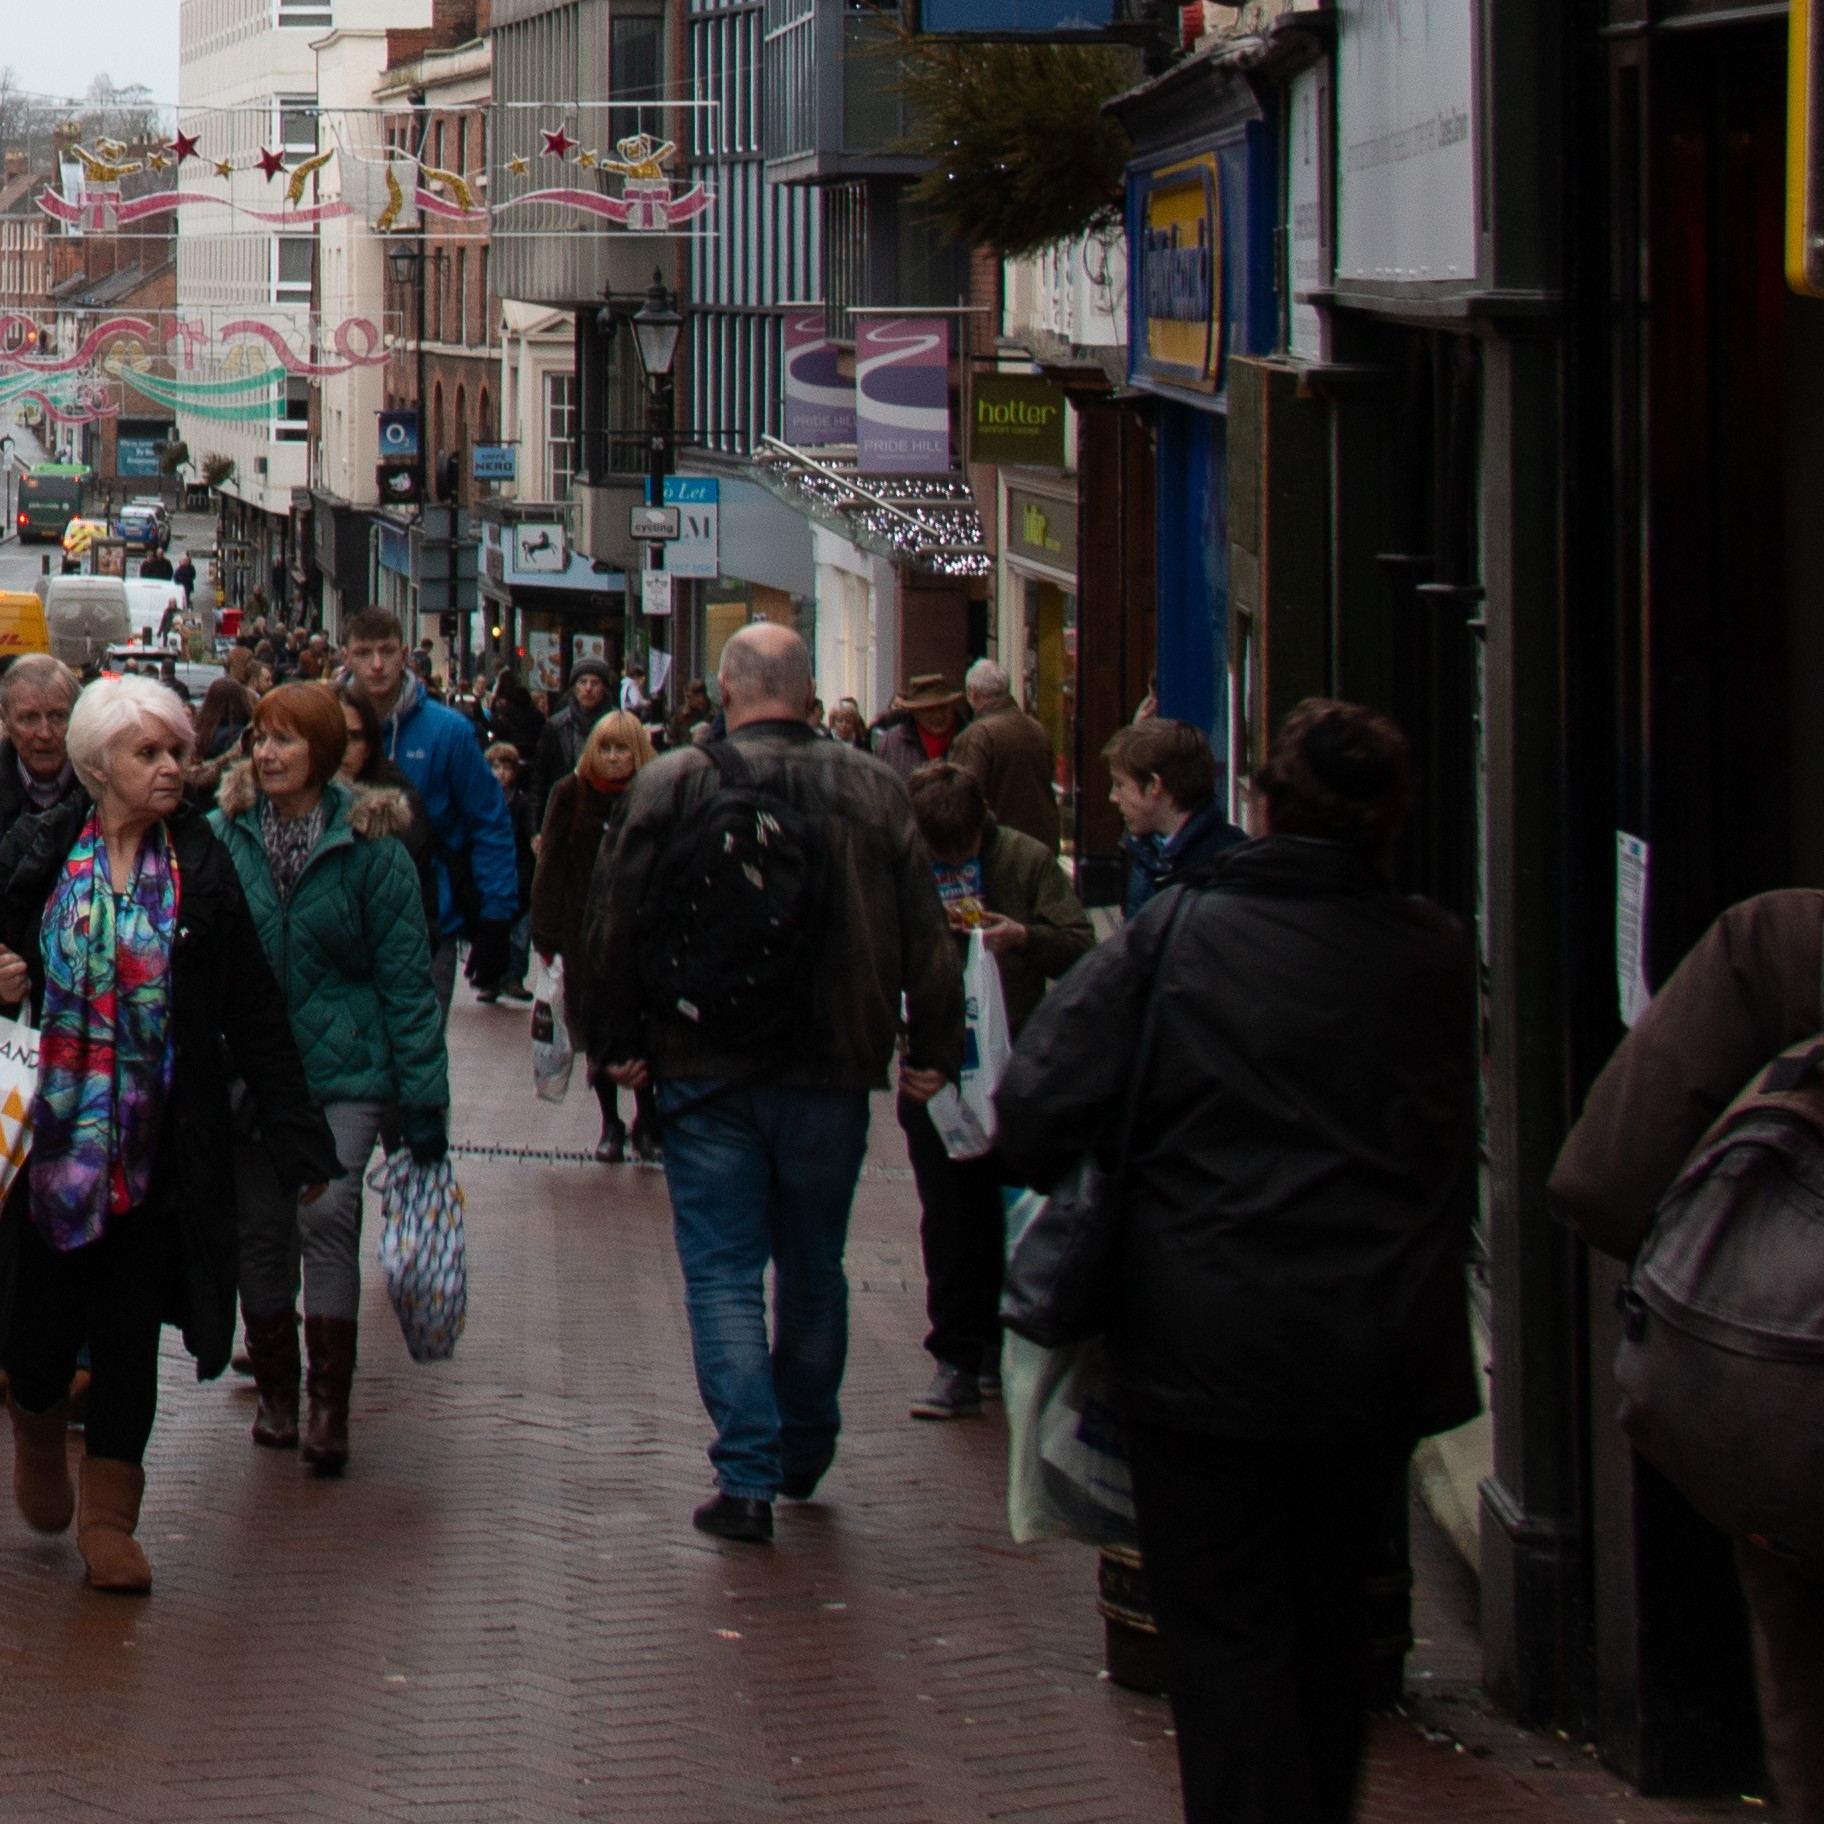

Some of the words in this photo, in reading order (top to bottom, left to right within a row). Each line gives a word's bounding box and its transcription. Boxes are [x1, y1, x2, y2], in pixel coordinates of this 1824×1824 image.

[977, 397, 1058, 426] hotter
[863, 439, 908, 453] PRIDE
[911, 439, 944, 453] HILL
